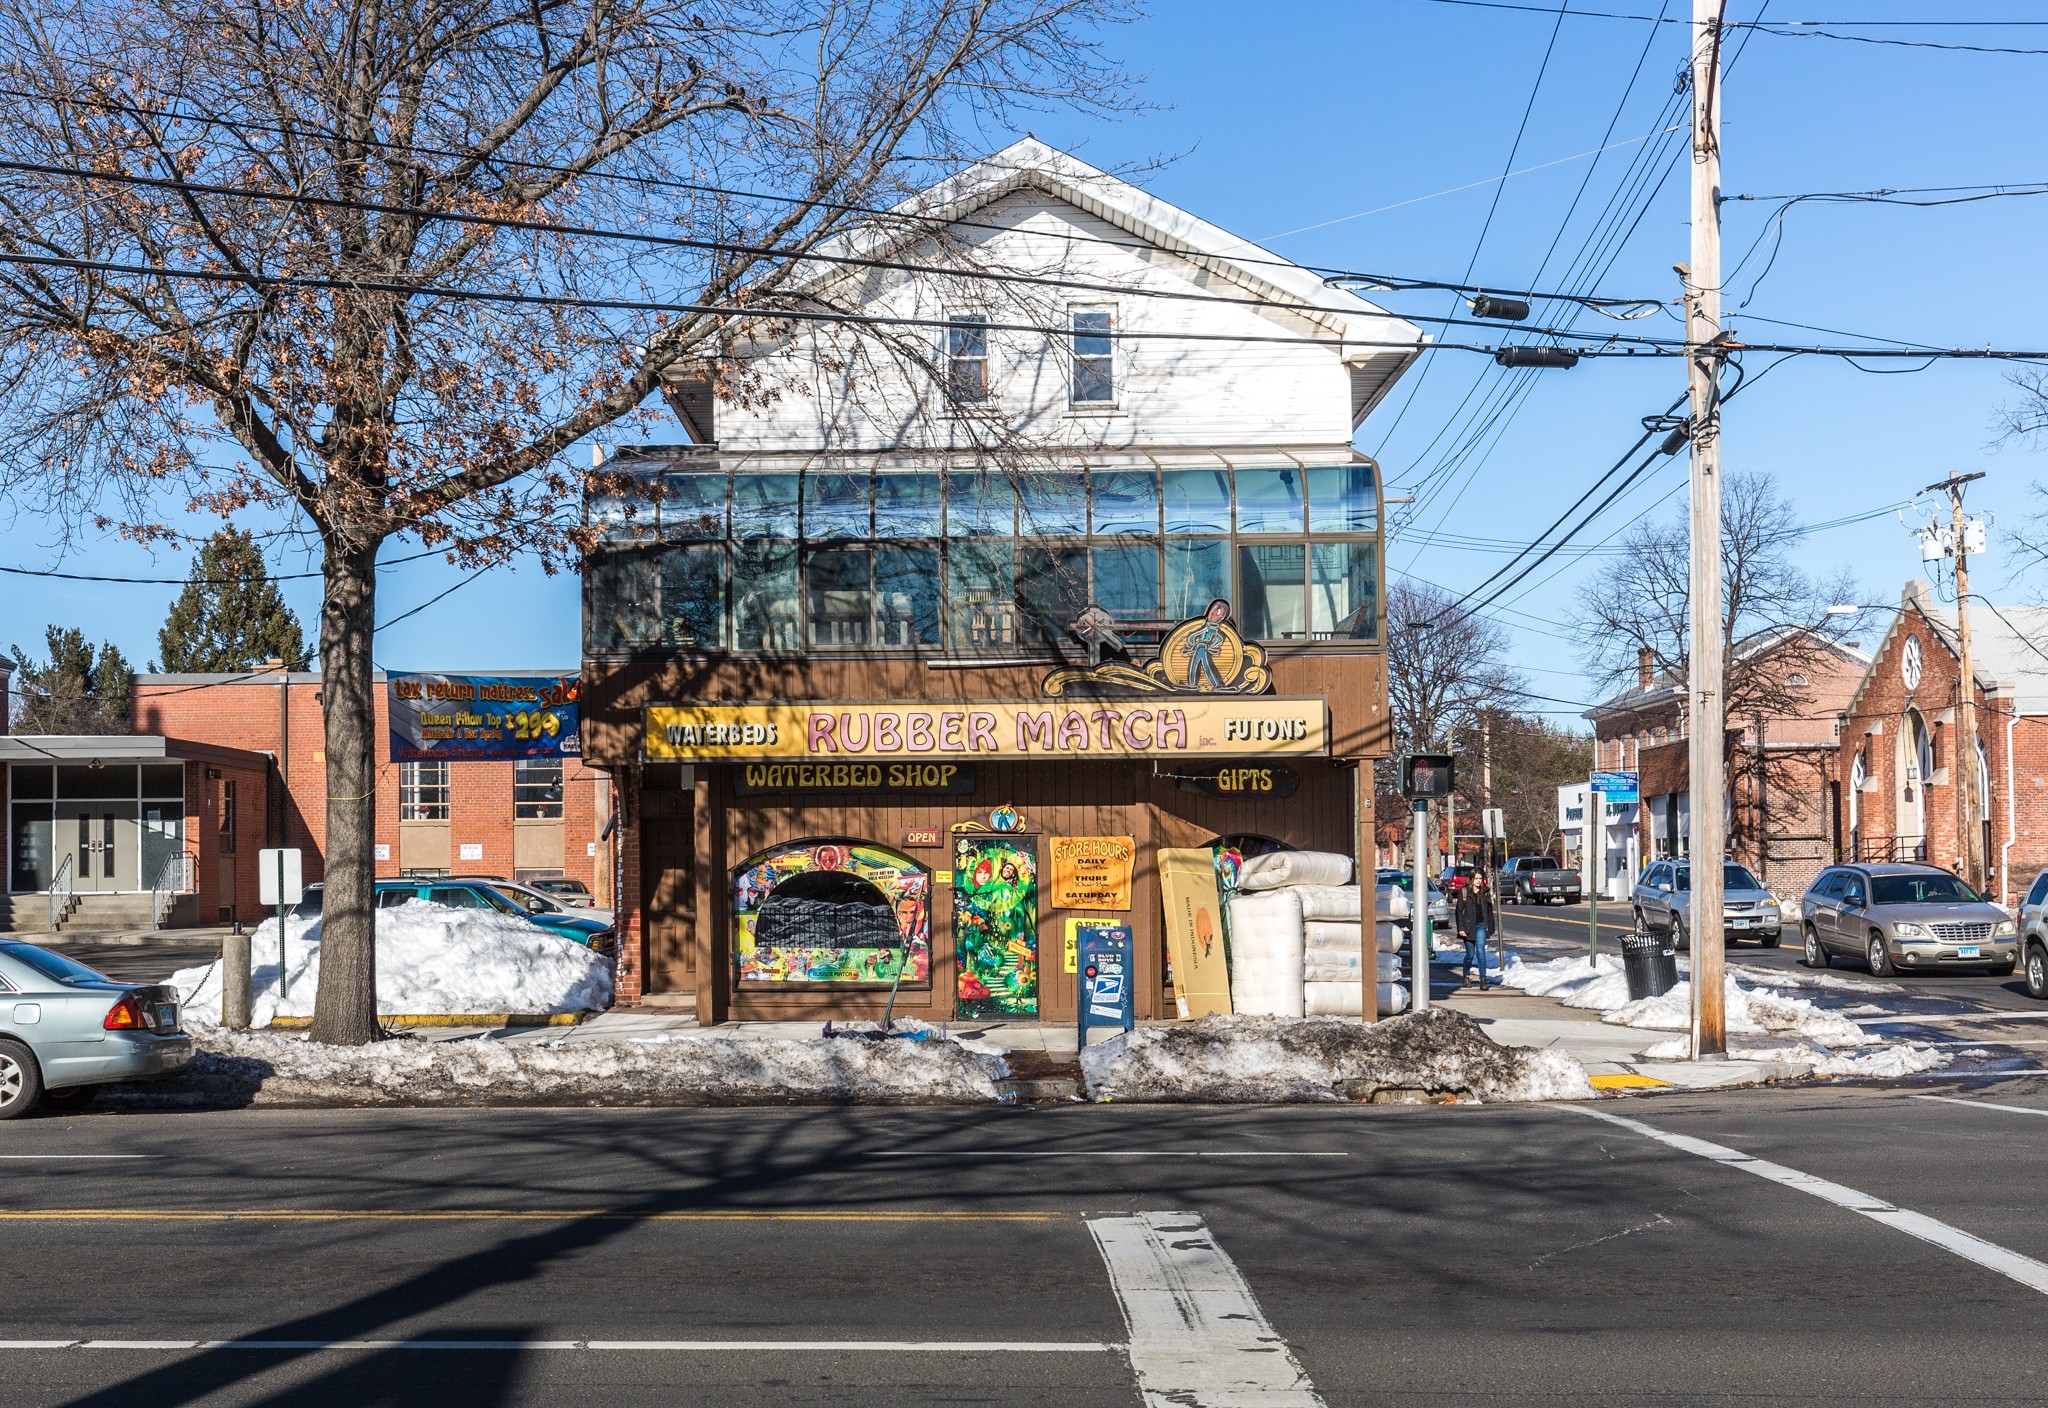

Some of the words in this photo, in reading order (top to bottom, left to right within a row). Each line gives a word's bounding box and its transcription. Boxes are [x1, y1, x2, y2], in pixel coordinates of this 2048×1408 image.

[395, 679, 421, 700] tax
[426, 681, 476, 701] return
[480, 682, 538, 701] mattress
[420, 711, 452, 727] Queen
[456, 711, 483, 726] Pillow
[486, 713, 502, 730] Top
[665, 722, 778, 746] WATERBEDS
[807, 711, 999, 752] RUBBER
[1016, 709, 1188, 751] MATCH
[1223, 717, 1307, 741] FUTONS
[745, 764, 882, 788] WATERBED
[888, 764, 958, 788] SHOP
[1218, 769, 1273, 791] GIFTS
[907, 832, 937, 843] OPEN
[1055, 841, 1090, 862] STORE
[1091, 840, 1130, 862] HOURS
[1188, 919, 1193, 927] IN
[1189, 929, 1199, 970] INDONESIA
